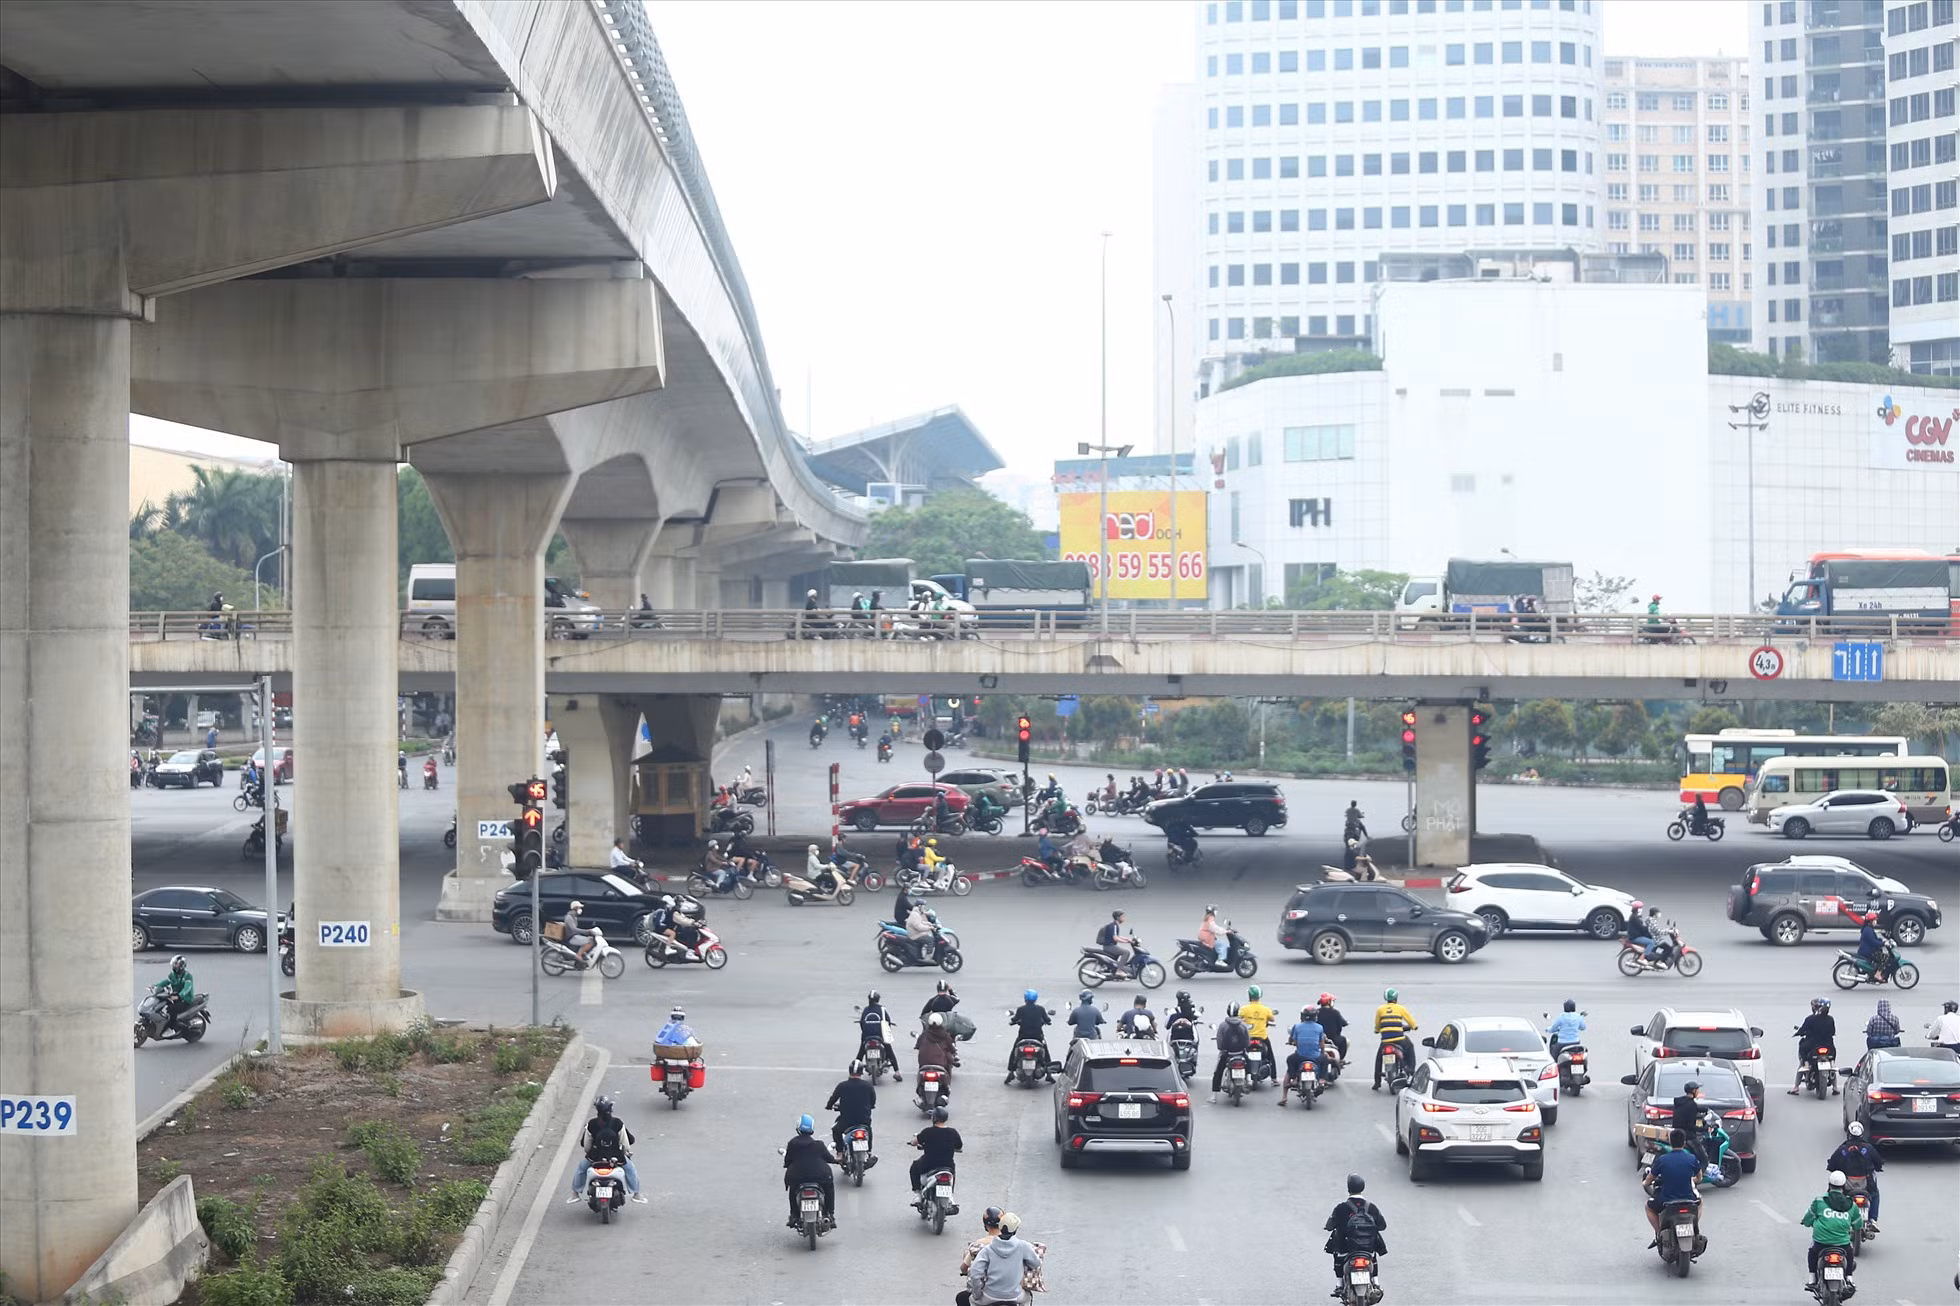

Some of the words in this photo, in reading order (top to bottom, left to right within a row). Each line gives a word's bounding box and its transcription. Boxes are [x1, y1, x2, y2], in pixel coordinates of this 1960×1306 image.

[1777, 403, 1800, 413] ELITE
[1803, 404, 1841, 416] FITNESS
[1905, 415, 1953, 446] CGV
[1906, 449, 1955, 464] CINEMAS
[1288, 498, 1331, 528] IPH
[1118, 553, 1142, 579] 59
[1148, 553, 1173, 579] 55
[1178, 553, 1203, 579] 66
[480, 823, 513, 837] P24
[321, 925, 368, 943] P240
[1, 1100, 72, 1130] P239
